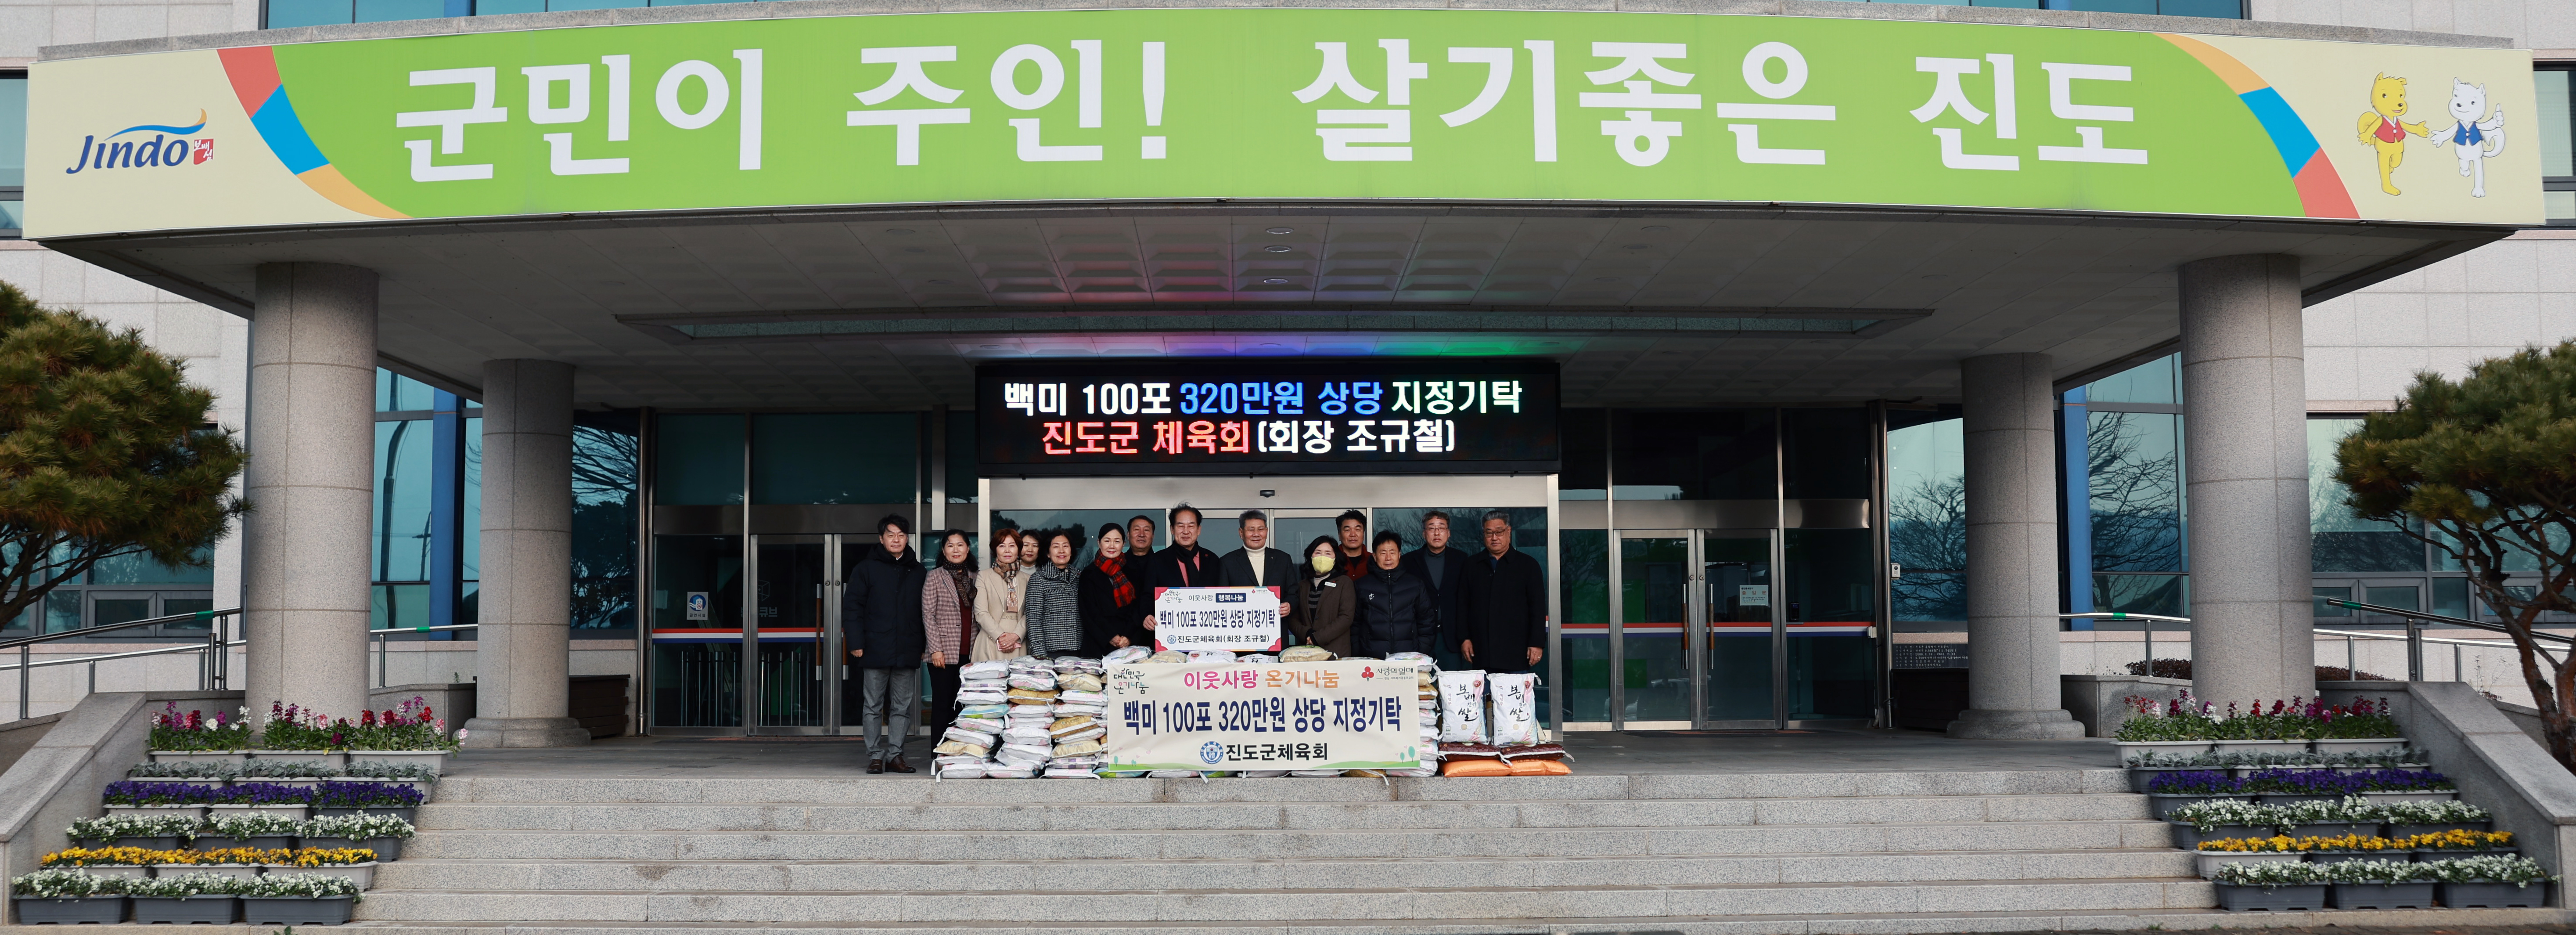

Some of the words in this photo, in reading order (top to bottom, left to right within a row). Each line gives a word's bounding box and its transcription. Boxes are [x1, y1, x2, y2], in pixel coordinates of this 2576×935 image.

[396, 49, 763, 184] 군민이
[847, 40, 1166, 166] 주인!
[1292, 39, 1836, 167] 살기좋은
[1909, 53, 2148, 172] 진도
[66, 134, 189, 174] Jindo
[1004, 383, 1066, 416] 백미
[1083, 383, 1171, 415] 100포
[1180, 381, 1304, 415] 320만원
[1317, 381, 1384, 415] 상당
[1391, 381, 1522, 415] 지정기탁
[1042, 421, 1139, 455] 진도군
[1347, 419, 1455, 453] 조규철)
[1160, 610, 1174, 628] 백미
[1176, 611, 1197, 628] 100포
[1199, 609, 1227, 628] 320만원
[1230, 609, 1244, 628] 상당
[1247, 609, 1275, 628] 지정기탁
[1113, 668, 1145, 680] 대한민국
[1184, 670, 1259, 690] 이웃사랑
[1265, 670, 1340, 688] 온기나눔
[1114, 681, 1149, 694] 온기나눔
[1124, 700, 1157, 735] 백미
[1163, 702, 1212, 733] 100포
[1219, 697, 1286, 733] 320만원
[1292, 697, 1326, 733] 상당
[1333, 696, 1402, 732] 지정기탁
[1457, 707, 1479, 722] 쌀
[1509, 708, 1530, 722] 쌀
[1226, 743, 1328, 761] 진도군체육회
